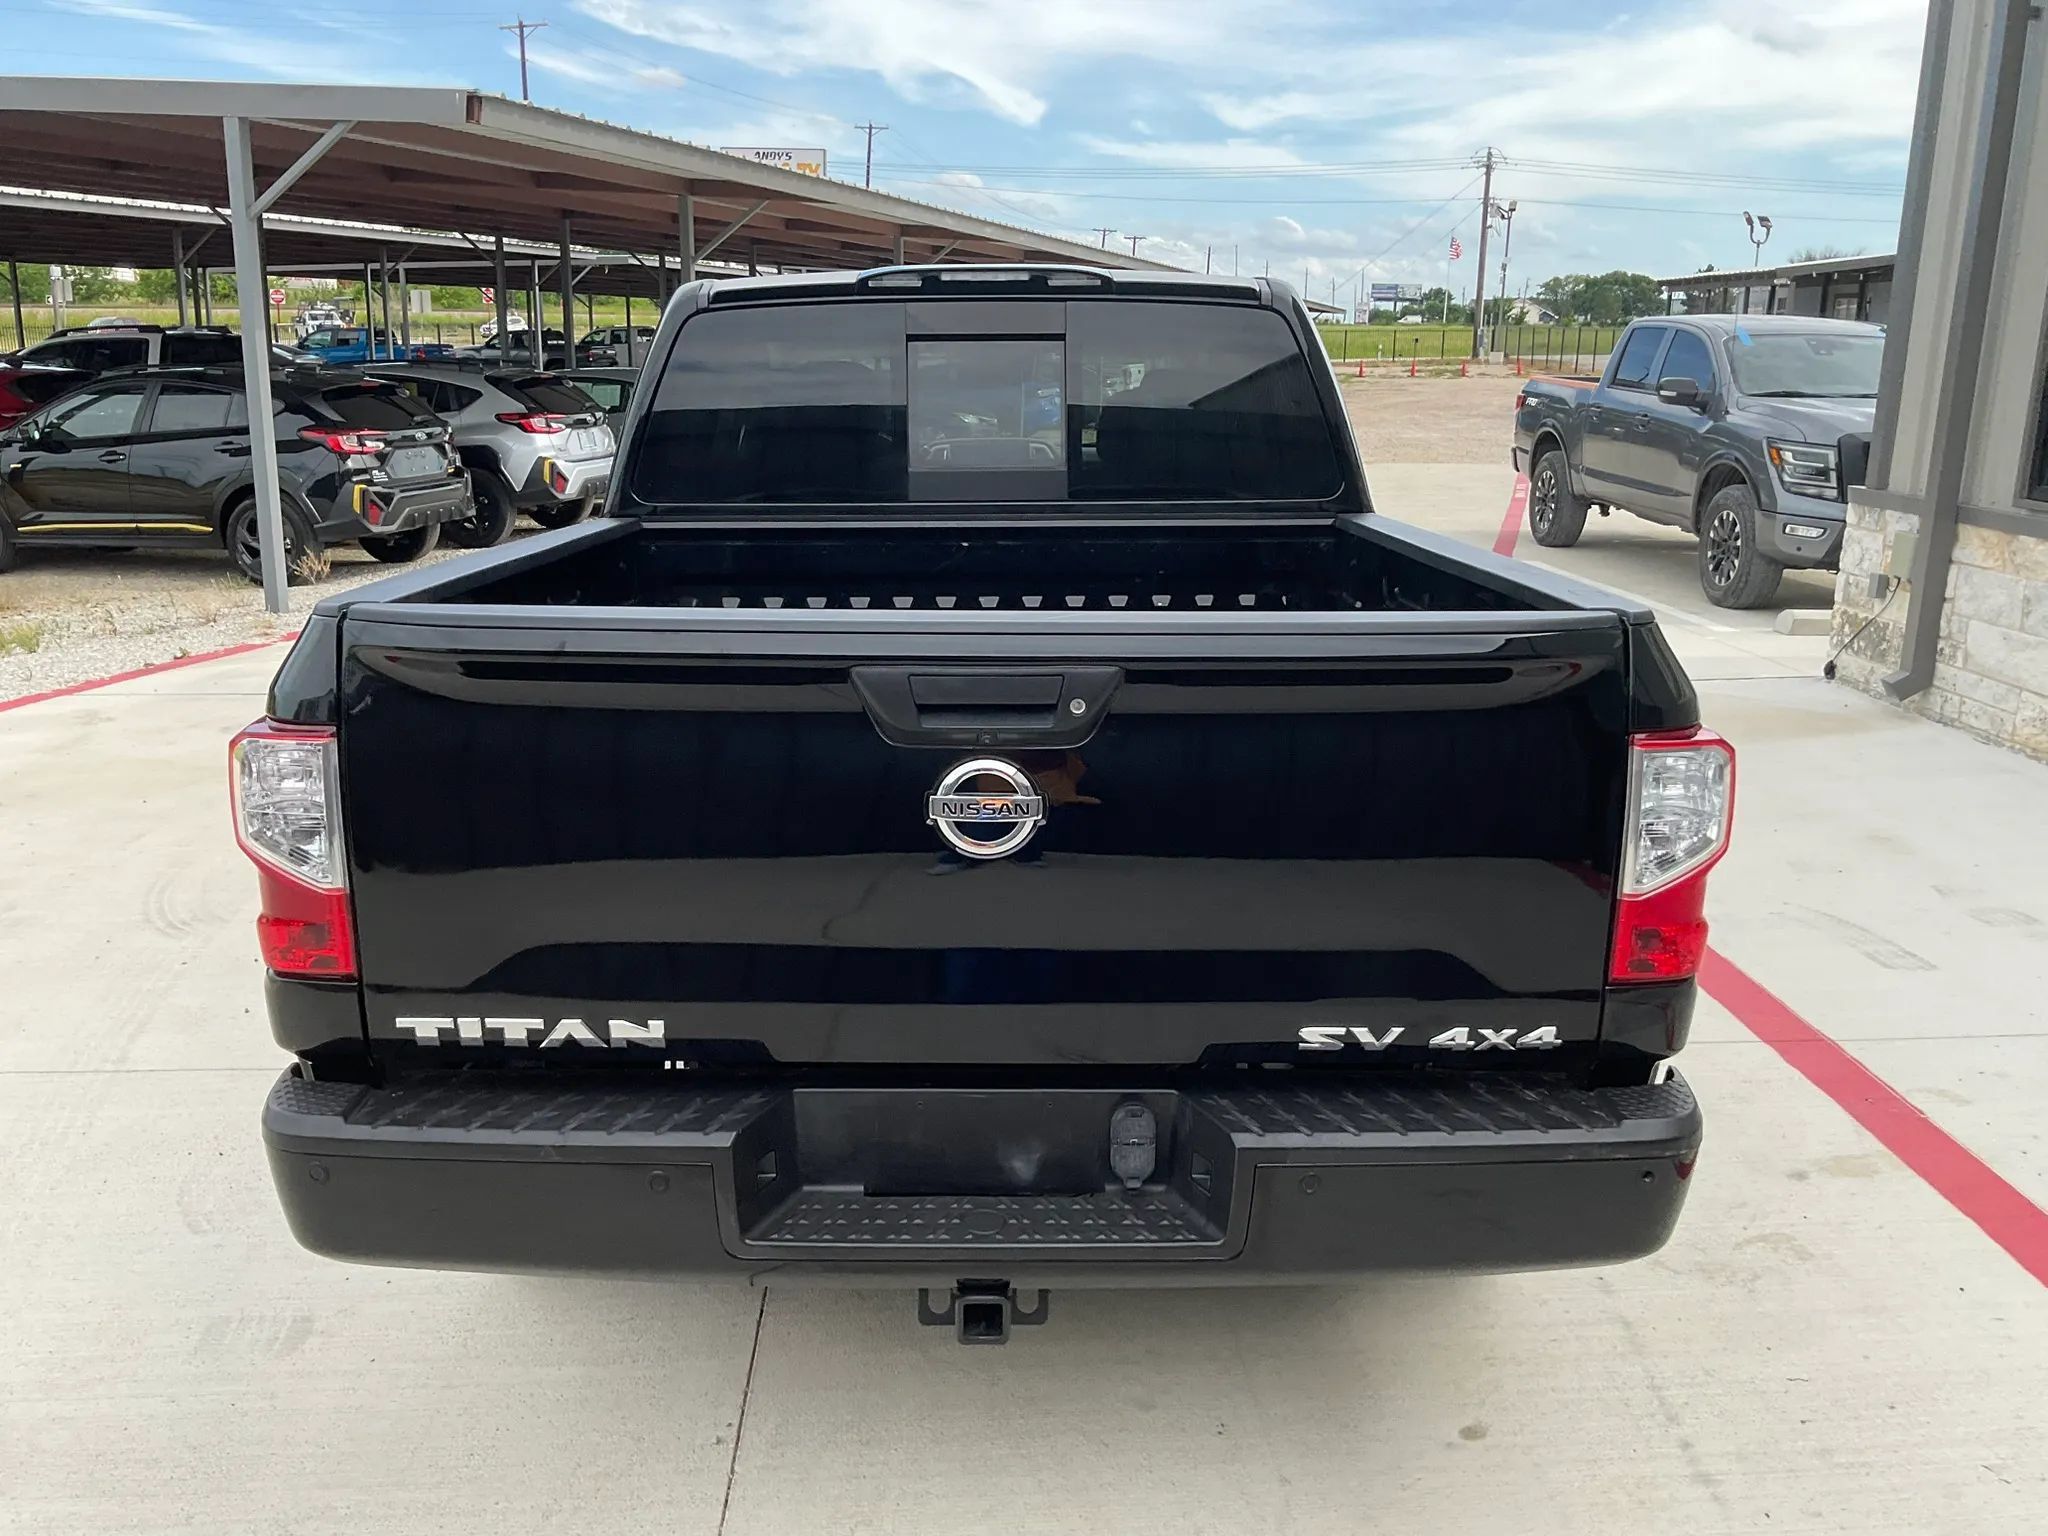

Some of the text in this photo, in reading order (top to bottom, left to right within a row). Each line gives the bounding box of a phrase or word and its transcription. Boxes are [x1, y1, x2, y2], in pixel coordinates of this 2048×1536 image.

[941, 802, 1029, 814] NISSAN
[395, 1017, 666, 1048] TITAN
[1298, 1026, 1405, 1051] SV
